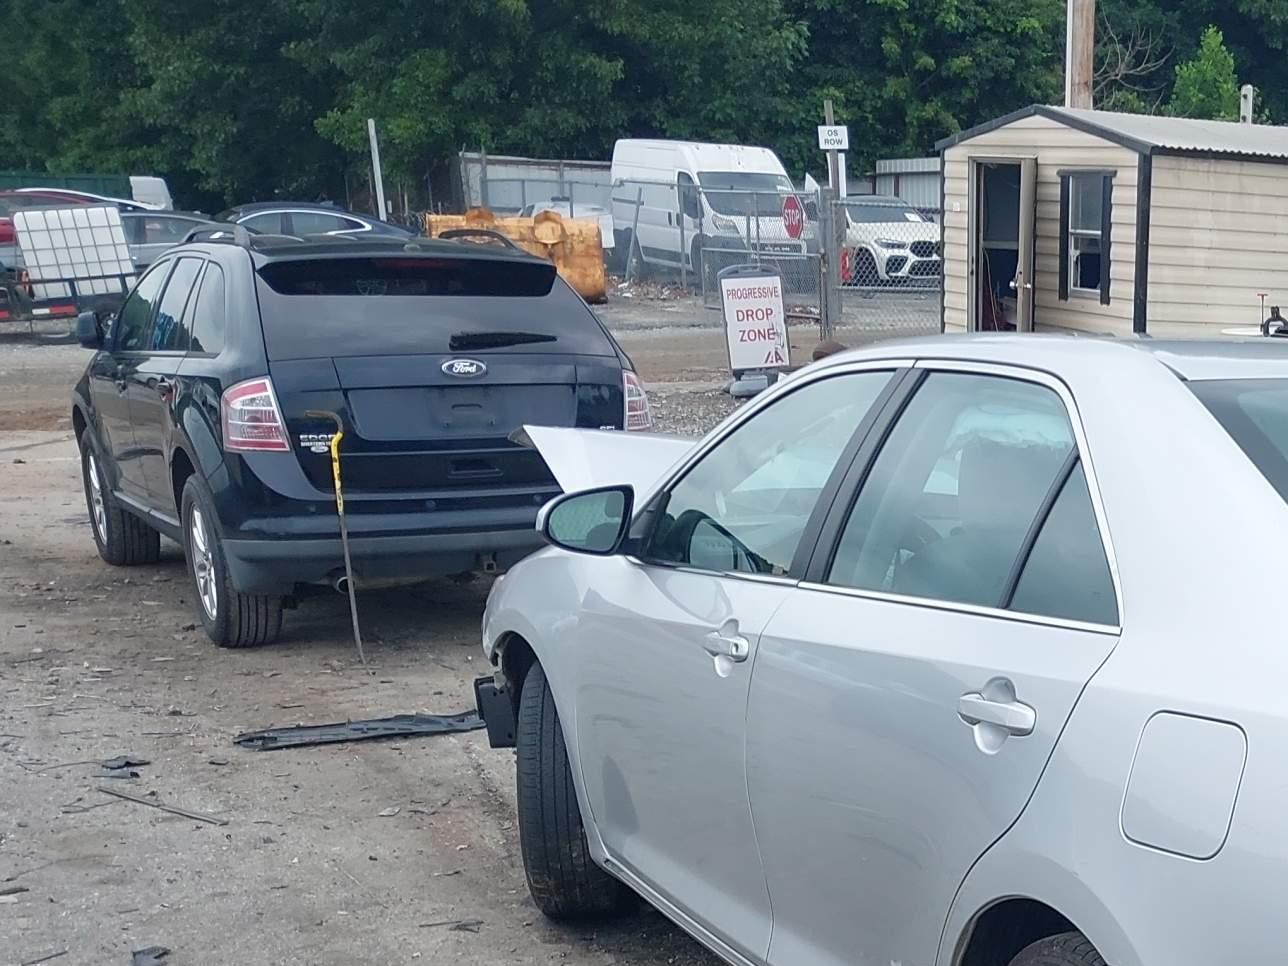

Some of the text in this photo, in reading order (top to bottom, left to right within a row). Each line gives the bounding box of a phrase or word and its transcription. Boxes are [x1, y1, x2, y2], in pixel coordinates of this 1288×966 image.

[827, 129, 839, 137] OS
[824, 138, 843, 146] ROW
[784, 208, 800, 226] STOP
[726, 286, 780, 300] PROGRESSIVE
[736, 307, 774, 322] DROP
[739, 328, 775, 342] ZONE
